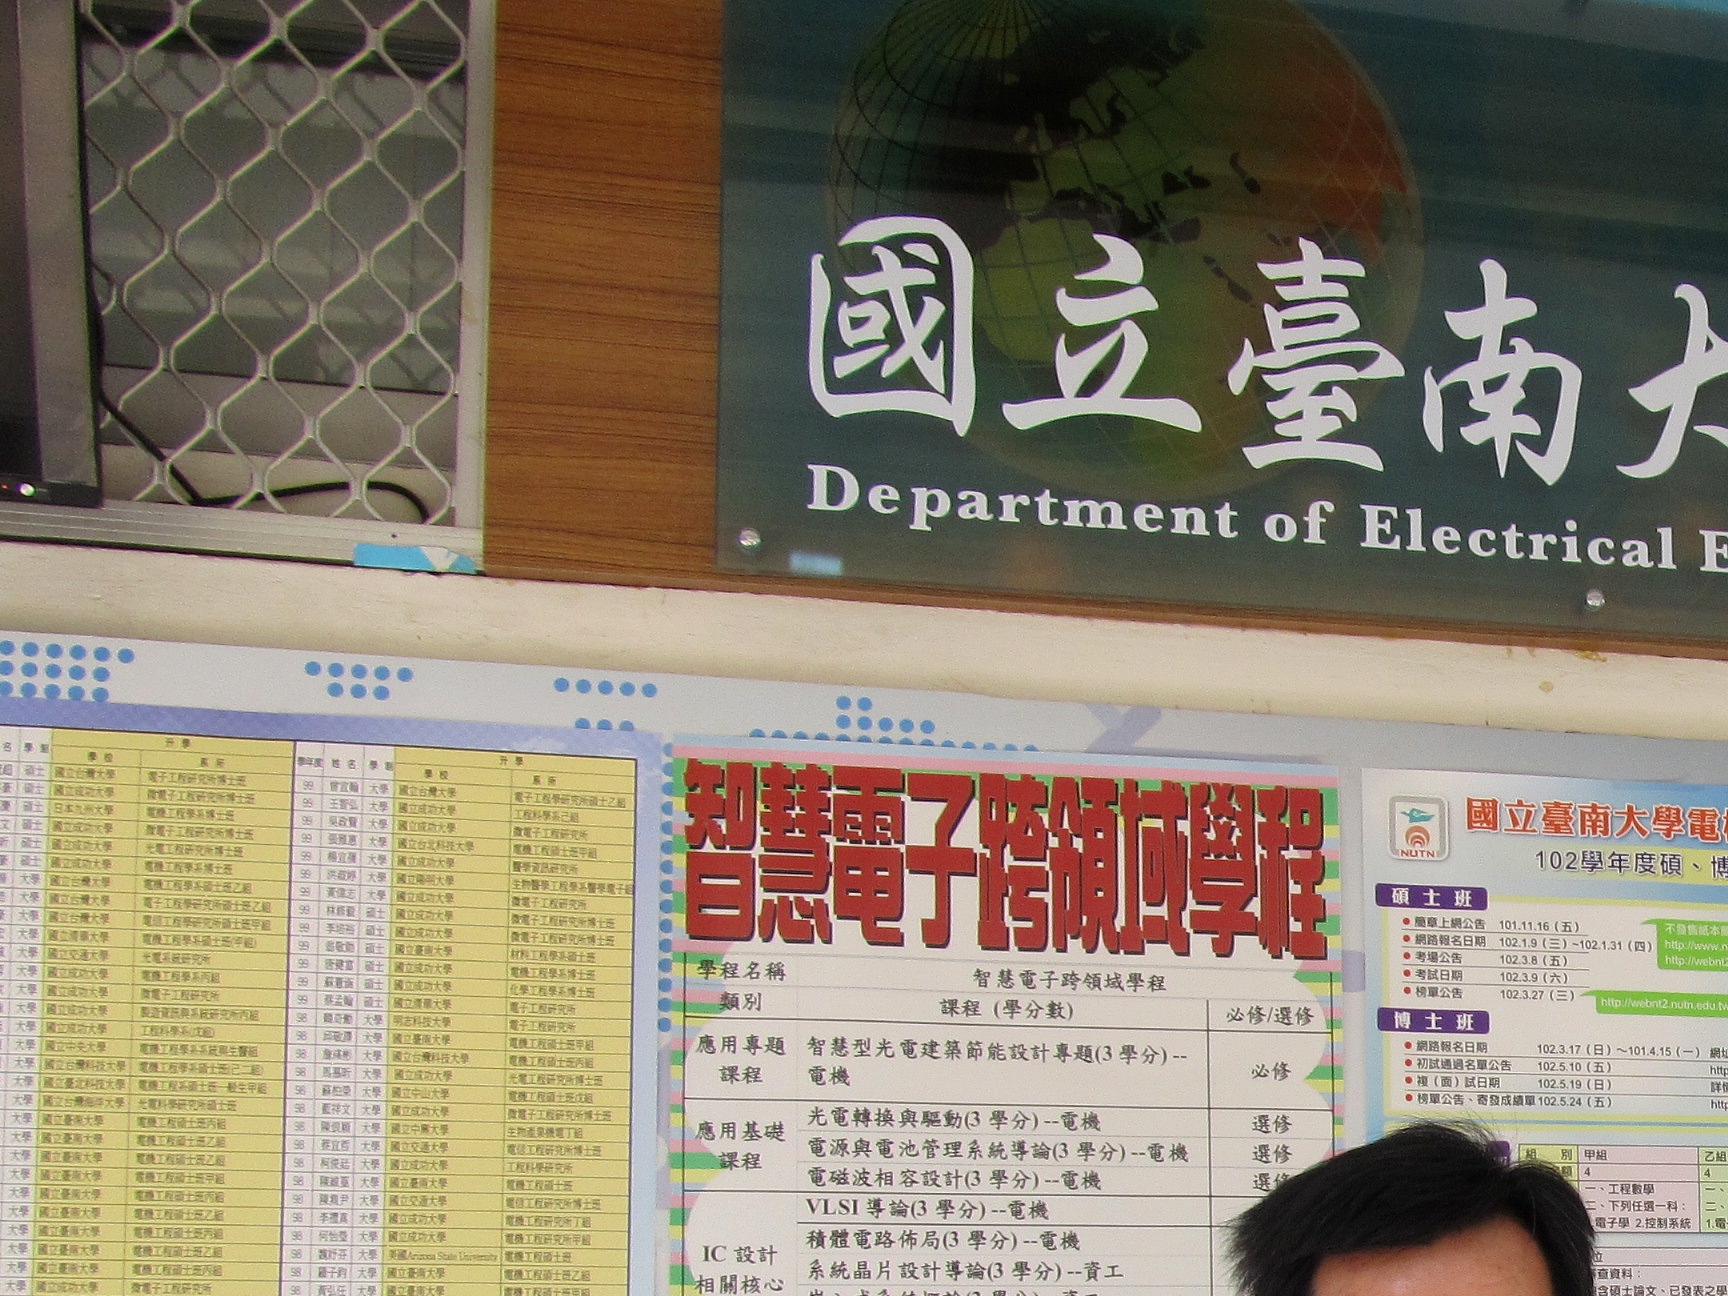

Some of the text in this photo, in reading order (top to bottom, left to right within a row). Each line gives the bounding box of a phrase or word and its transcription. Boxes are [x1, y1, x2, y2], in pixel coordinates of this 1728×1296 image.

[807, 463, 1237, 538] Department
[1265, 500, 1334, 546] of
[1360, 505, 1676, 571] Electrical
[684, 759, 1328, 960] 智慧電子跨領域學程
[1400, 849, 1435, 858] NUTN
[1414, 916, 1486, 930] 簡章上網公告
[1415, 934, 1486, 948] 網路報名日期
[1415, 951, 1462, 964] 考場公告
[697, 960, 1166, 992] 學程名稱 智慧電子跨領域學程
[1415, 968, 1463, 982] 考試日期
[1415, 986, 1463, 999] 榜單公告
[719, 992, 762, 1012] 類別
[1226, 1007, 1314, 1025] 必修/選修
[697, 1034, 786, 1055] 應用專題
[1416, 1040, 1488, 1054] 網路報名日期
[719, 1062, 1291, 1086] 課程 電機 必修
[1252, 1115, 1292, 1133] 選修
[697, 1121, 786, 1141] 應用基礎
[1252, 1144, 1293, 1163] 選修
[720, 1152, 762, 1170] 課程
[1584, 1150, 1607, 1161] 甲組
[1705, 1151, 1727, 1162] 乙組
[1584, 1167, 1590, 1176] 4
[1704, 1169, 1711, 1178] 4
[806, 1199, 858, 1216] VLSI
[703, 1245, 777, 1265] IC 設計
[695, 1274, 783, 1295] 相關核心
